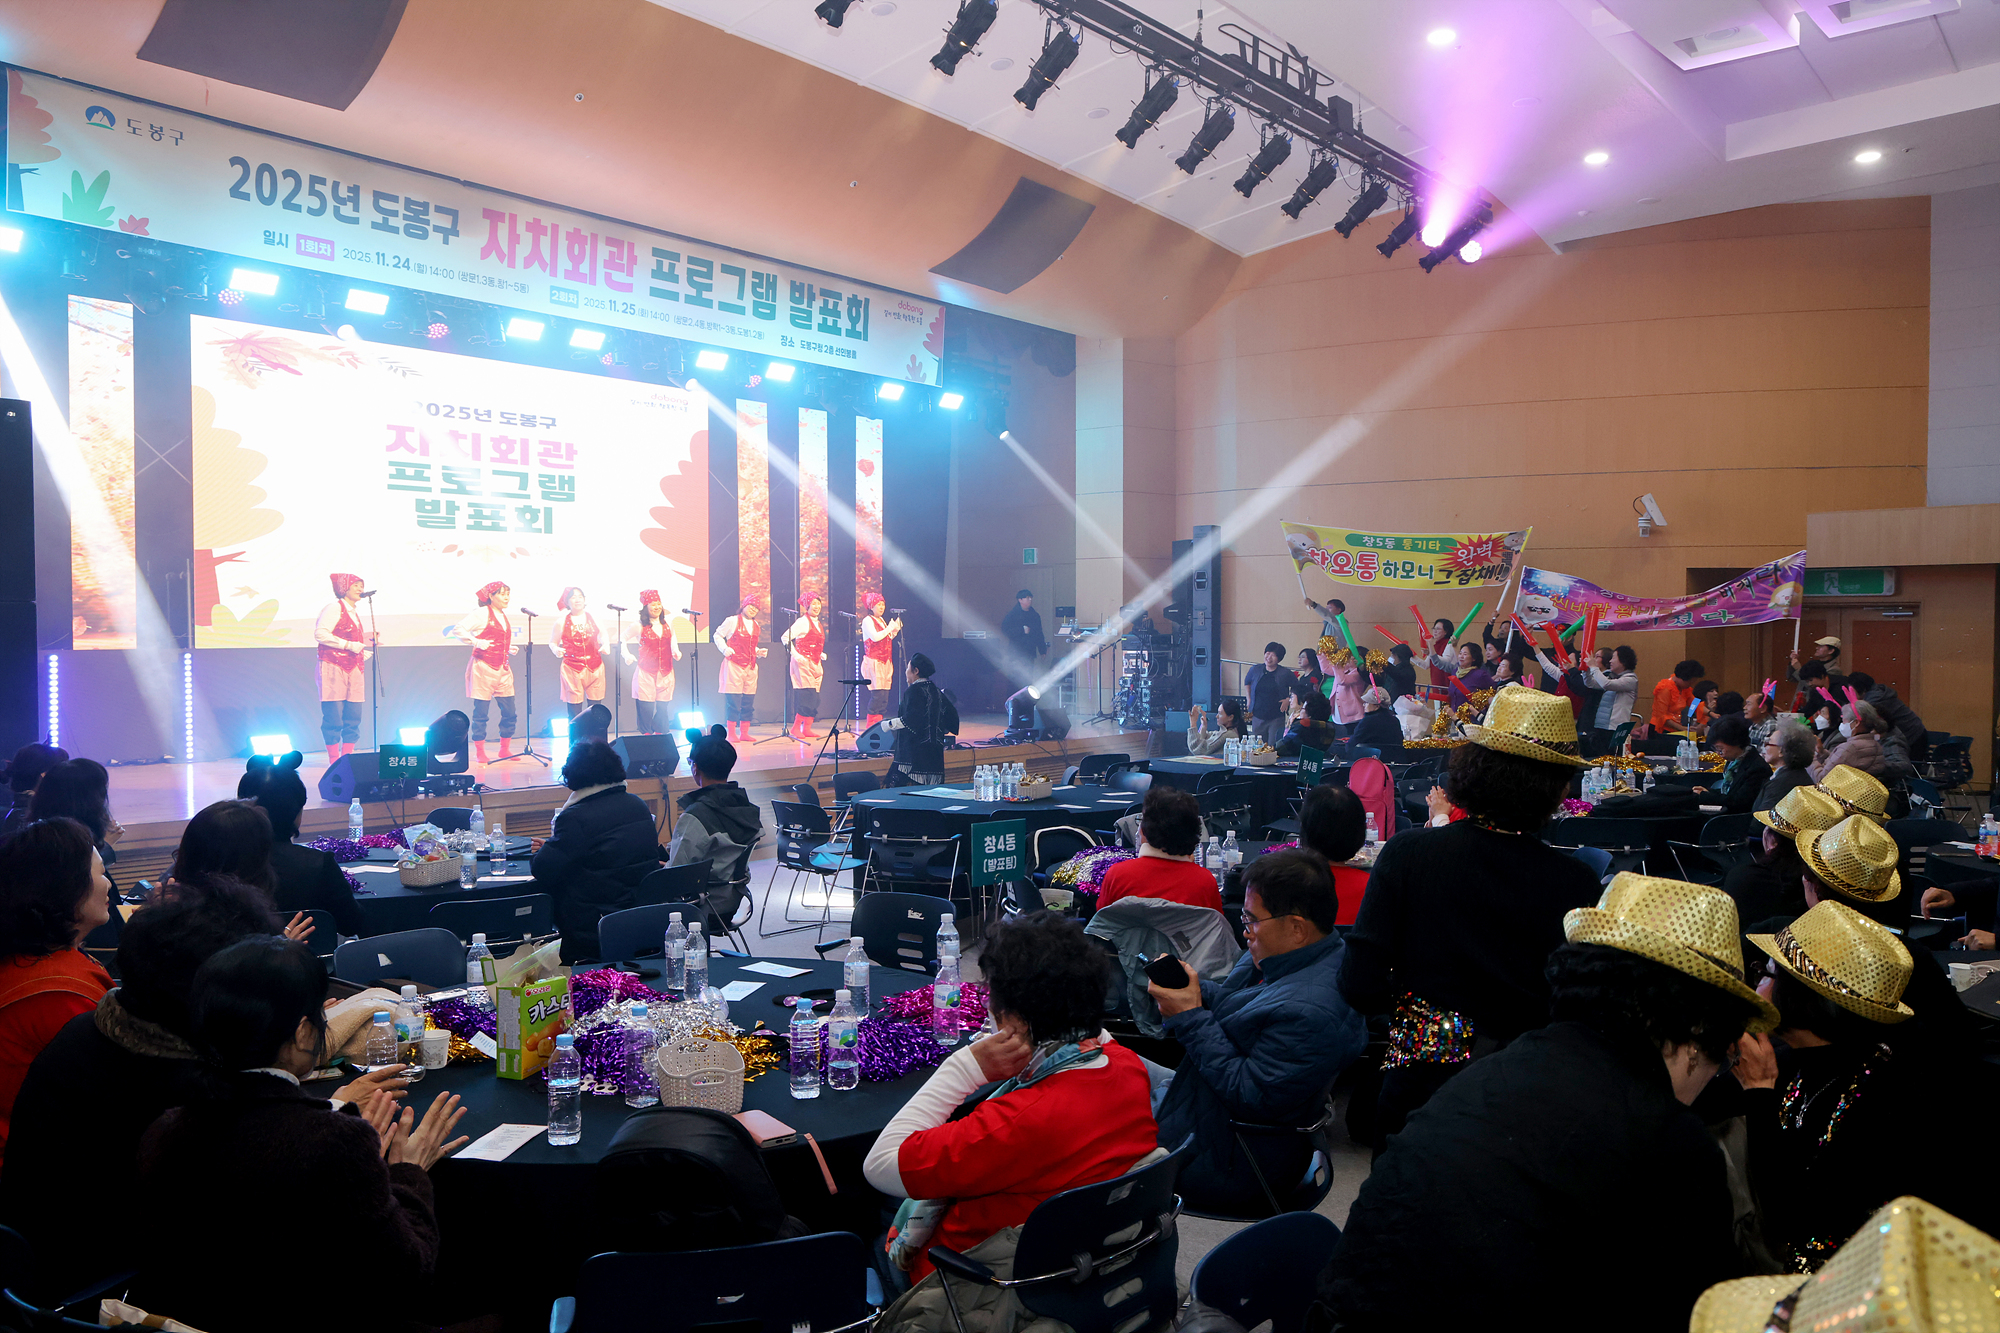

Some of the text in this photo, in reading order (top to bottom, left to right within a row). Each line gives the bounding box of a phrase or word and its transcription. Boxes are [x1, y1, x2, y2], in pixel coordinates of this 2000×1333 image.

[126, 118, 185, 147] 도봉구
[228, 155, 870, 342] 2025년 도봉구 자치회관 프로그램 발표회
[263, 229, 289, 249] 일시
[299, 238, 333, 257] 1회차
[429, 265, 455, 280] 14:00
[551, 289, 578, 305] 2회차
[650, 309, 670, 323] 14:00
[898, 300, 924, 316] dobong
[780, 334, 796, 348] 장소
[499, 410, 558, 430] 도봉구
[385, 423, 579, 470] 자치회관
[386, 460, 577, 503] 프로그램
[414, 497, 554, 535] 발표회
[1362, 535, 1441, 551] 창5동 통기타
[1457, 540, 1493, 566] 완벽
[1382, 559, 1435, 580] 하모니
[1434, 569, 1454, 585] 그
[388, 756, 418, 767] 창4동
[984, 833, 1016, 854] 창4동
[983, 855, 1017, 873] (발표팀)
